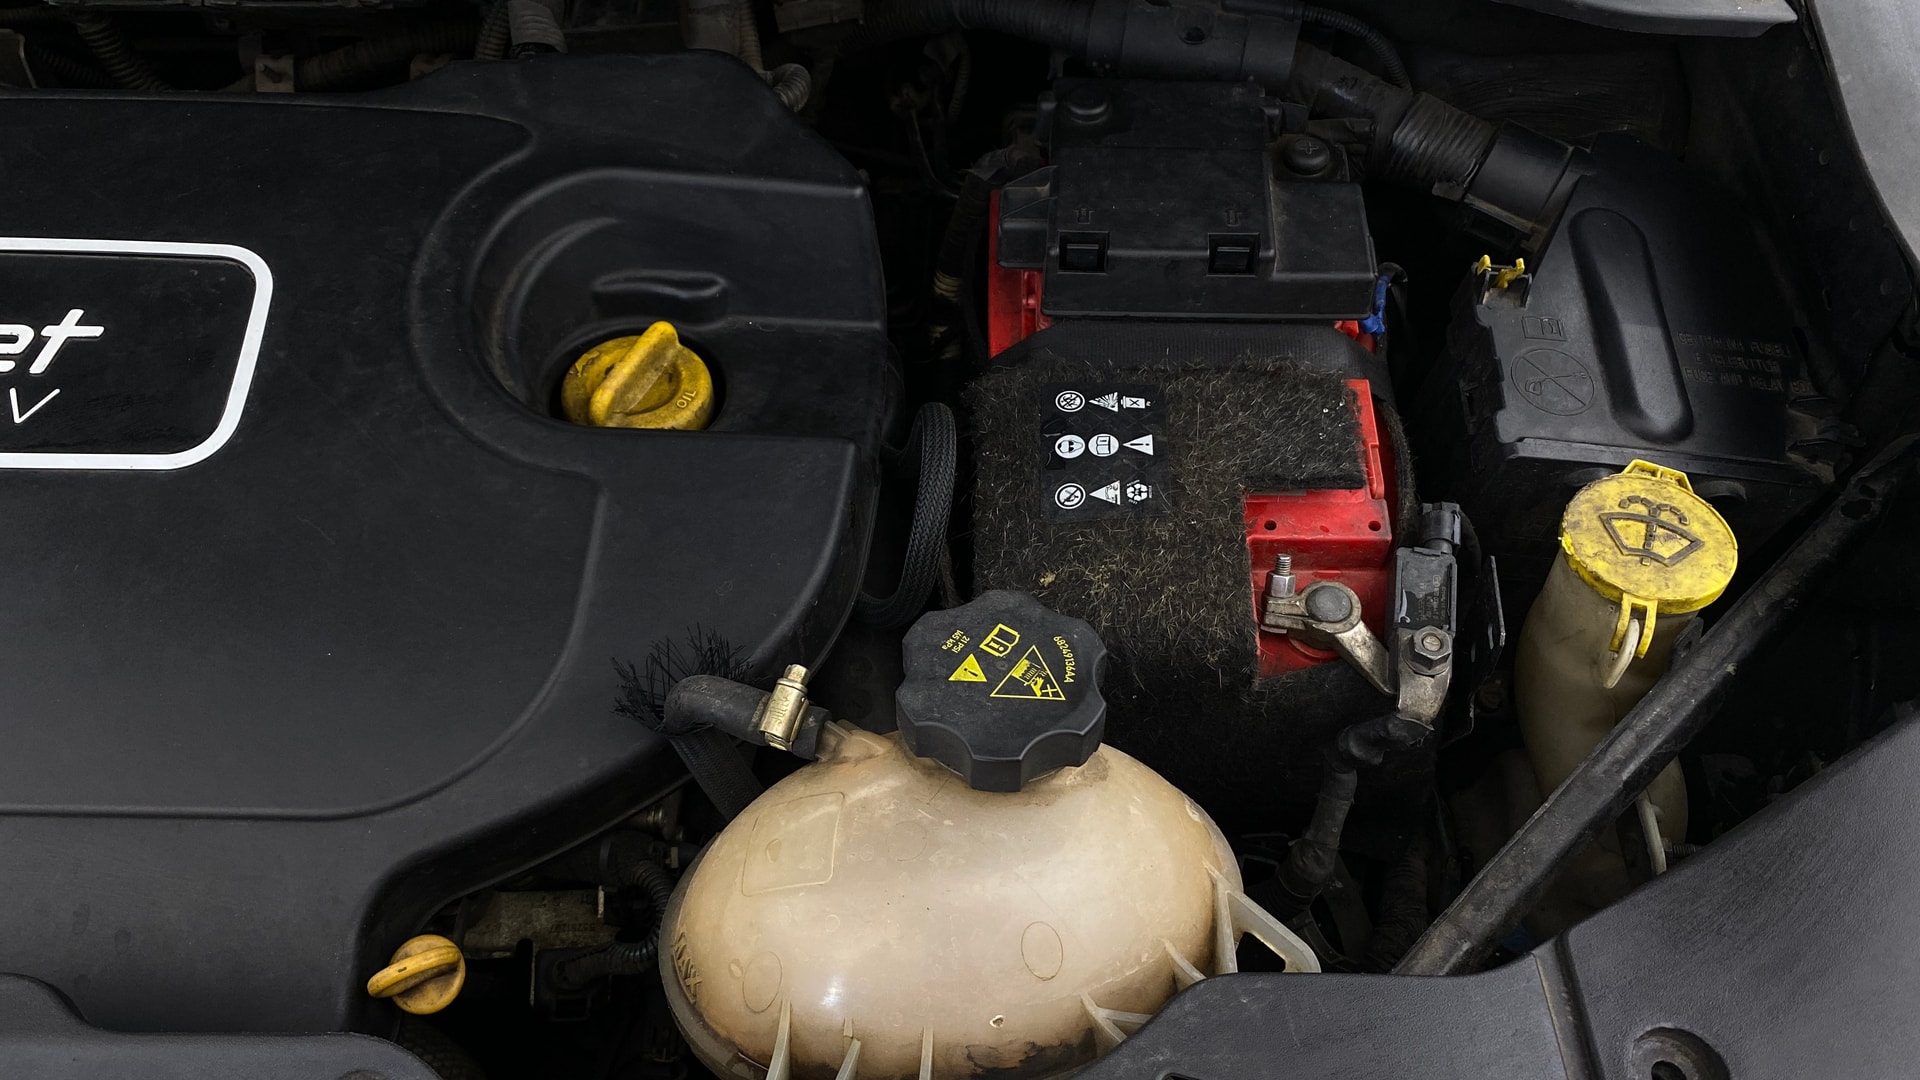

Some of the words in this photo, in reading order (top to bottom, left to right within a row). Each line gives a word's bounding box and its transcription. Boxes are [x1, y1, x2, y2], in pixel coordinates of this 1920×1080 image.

[676, 391, 697, 408] OIL
[951, 641, 965, 654] PSI
[1053, 635, 1076, 683] 68249136AA
